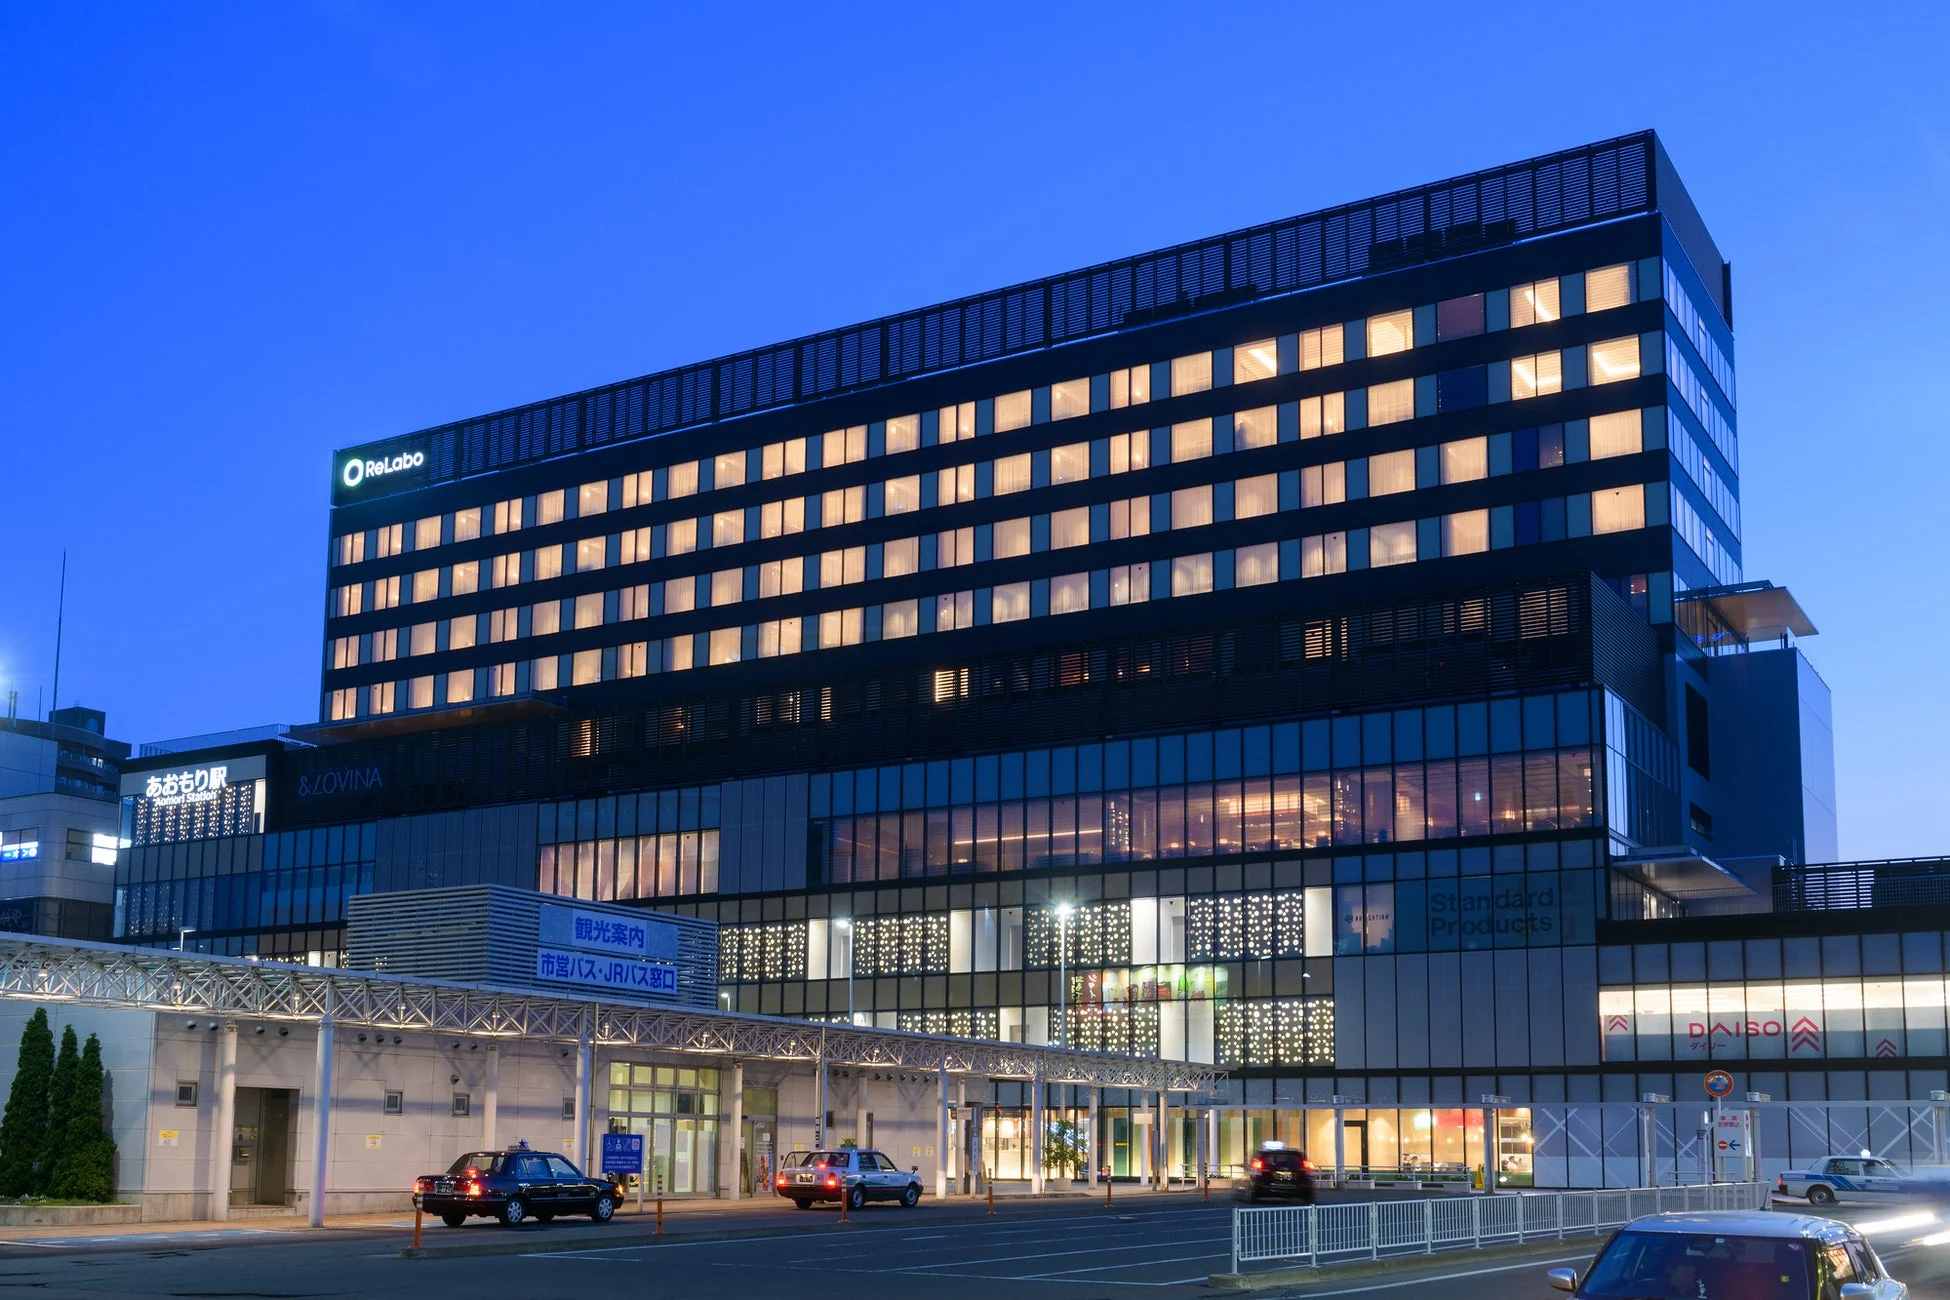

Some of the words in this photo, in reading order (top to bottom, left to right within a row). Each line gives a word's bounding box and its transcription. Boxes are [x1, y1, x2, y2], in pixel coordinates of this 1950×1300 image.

[365, 451, 424, 478] ReLabo
[145, 766, 228, 797] あおもり駅
[153, 794, 185, 806] Aomori
[186, 791, 217, 803] Station
[1430, 887, 1554, 913] Standard
[575, 916, 645, 949] 観光案内
[1430, 912, 1553, 937] Products
[541, 953, 675, 990] 市営バス・JRバス窓口
[1688, 1020, 1782, 1038] DAISO
